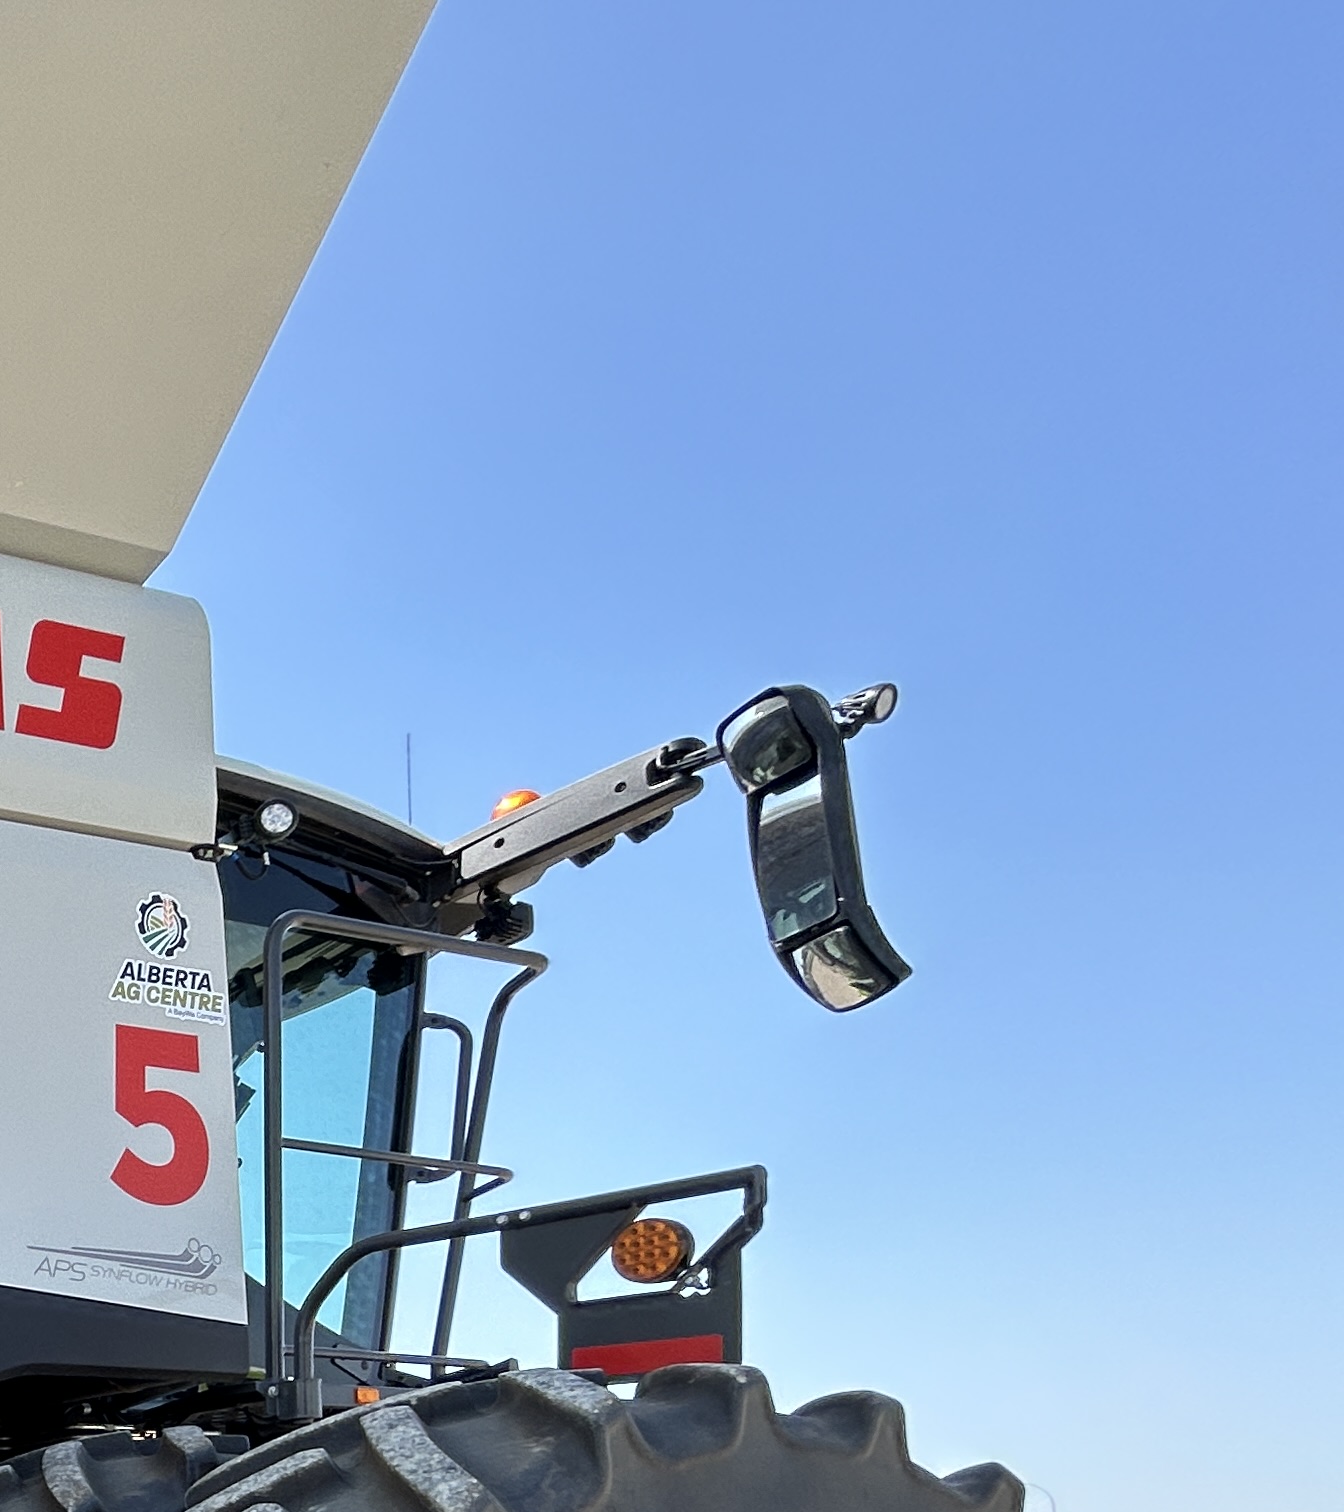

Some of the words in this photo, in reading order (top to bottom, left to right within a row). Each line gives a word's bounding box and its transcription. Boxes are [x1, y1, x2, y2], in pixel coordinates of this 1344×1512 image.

[120, 962, 212, 992] ALBERTA
[112, 981, 141, 1001] AG
[146, 986, 223, 1013] CENTRE
[110, 1024, 210, 1206] 5
[34, 1256, 87, 1282] APS
[90, 1264, 163, 1287] SYNFLOW
[165, 1277, 218, 1296] HYBRID
